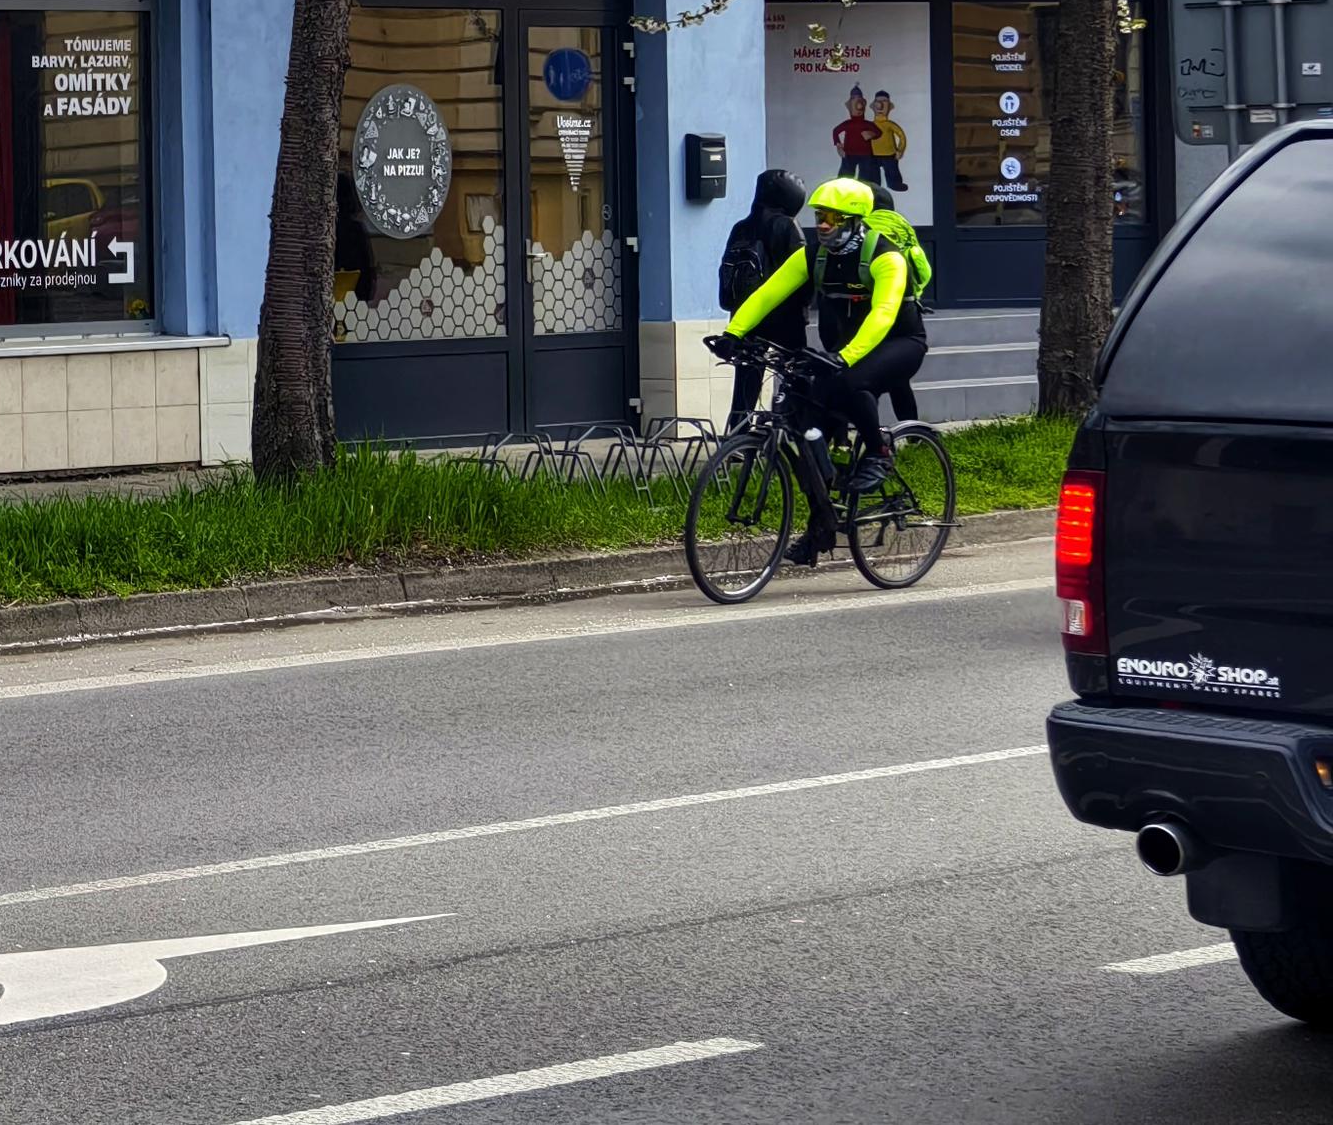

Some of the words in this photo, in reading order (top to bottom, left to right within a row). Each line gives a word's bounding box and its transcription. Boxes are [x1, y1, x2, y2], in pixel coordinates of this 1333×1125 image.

[64, 36, 132, 52] TÓNUJEME
[824, 45, 872, 58] POŠTĚNÍ
[32, 55, 77, 69] BARVY,
[80, 55, 132, 69] LAZURY,
[54, 69, 131, 92] OMÍTKY
[43, 104, 54, 116] A
[57, 93, 132, 116] FASÁDY
[387, 148, 404, 159] JAK
[405, 148, 421, 159] JE?
[383, 165, 396, 176] NA
[398, 165, 424, 176] PIZZU!
[30, 277, 42, 287] za
[45, 273, 97, 289] prodejnou
[1117, 657, 1189, 677] ENDURO
